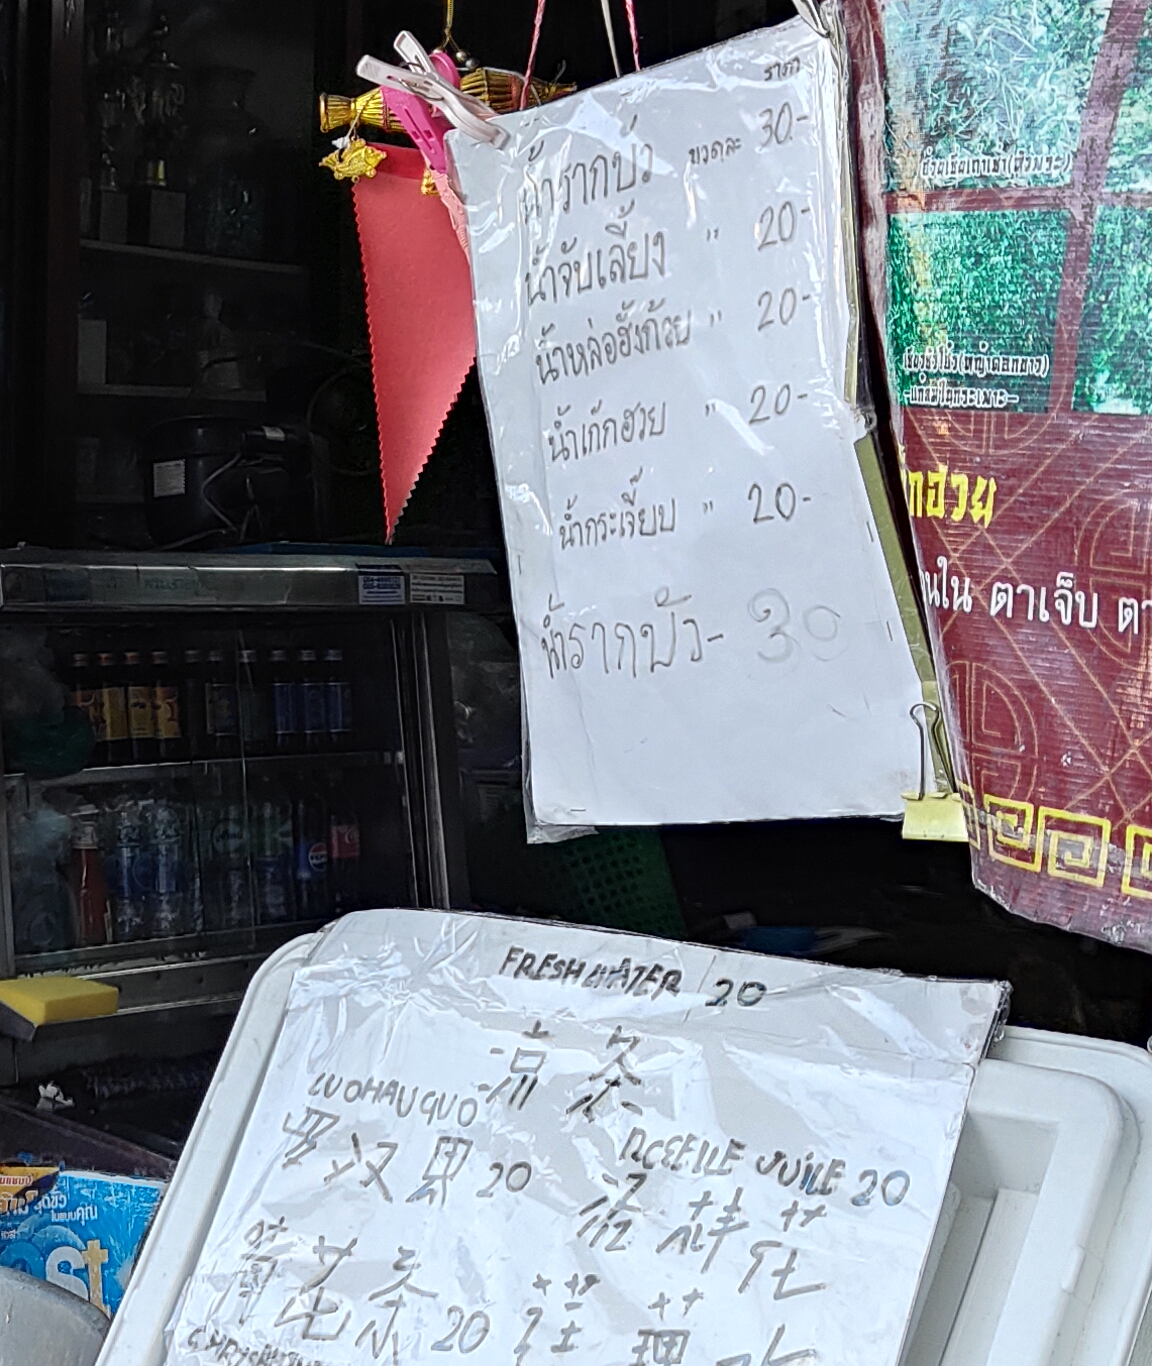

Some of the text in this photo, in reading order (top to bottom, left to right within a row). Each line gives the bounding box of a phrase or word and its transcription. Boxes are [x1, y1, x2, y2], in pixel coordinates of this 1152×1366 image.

[989, 571, 1098, 628] ตาเจ็บ
[705, 977, 768, 1009] 20
[476, 1160, 532, 1198] 20
[851, 1169, 910, 1207] 20
[431, 1306, 490, 1353] 20
